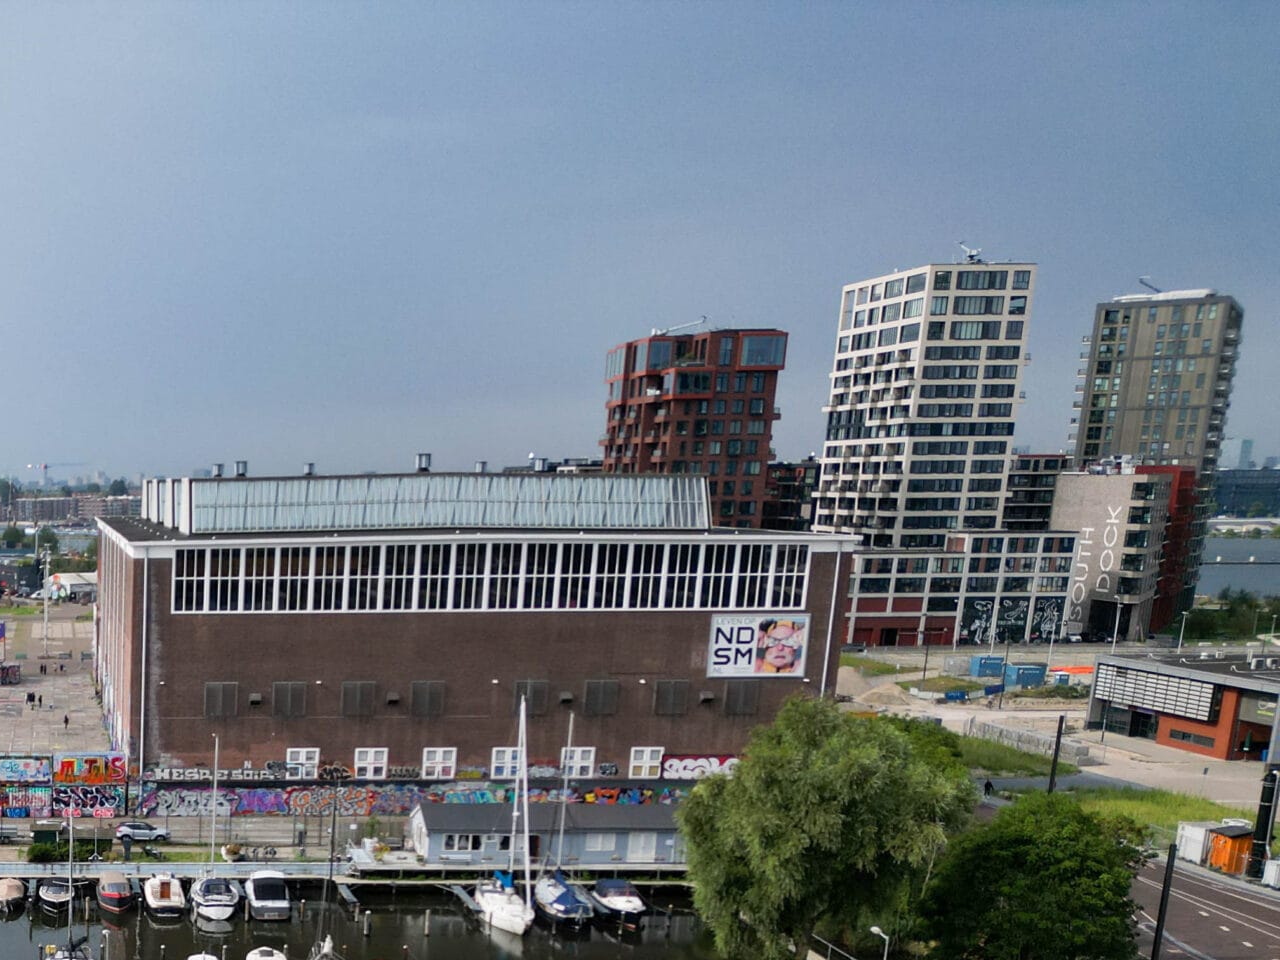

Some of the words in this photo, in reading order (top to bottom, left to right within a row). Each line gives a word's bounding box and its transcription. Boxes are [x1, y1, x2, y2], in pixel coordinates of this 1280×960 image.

[1069, 527, 1095, 621] SOUTH
[1095, 505, 1122, 593] DOCK
[712, 647, 753, 666] SM
[714, 626, 755, 645] ND
